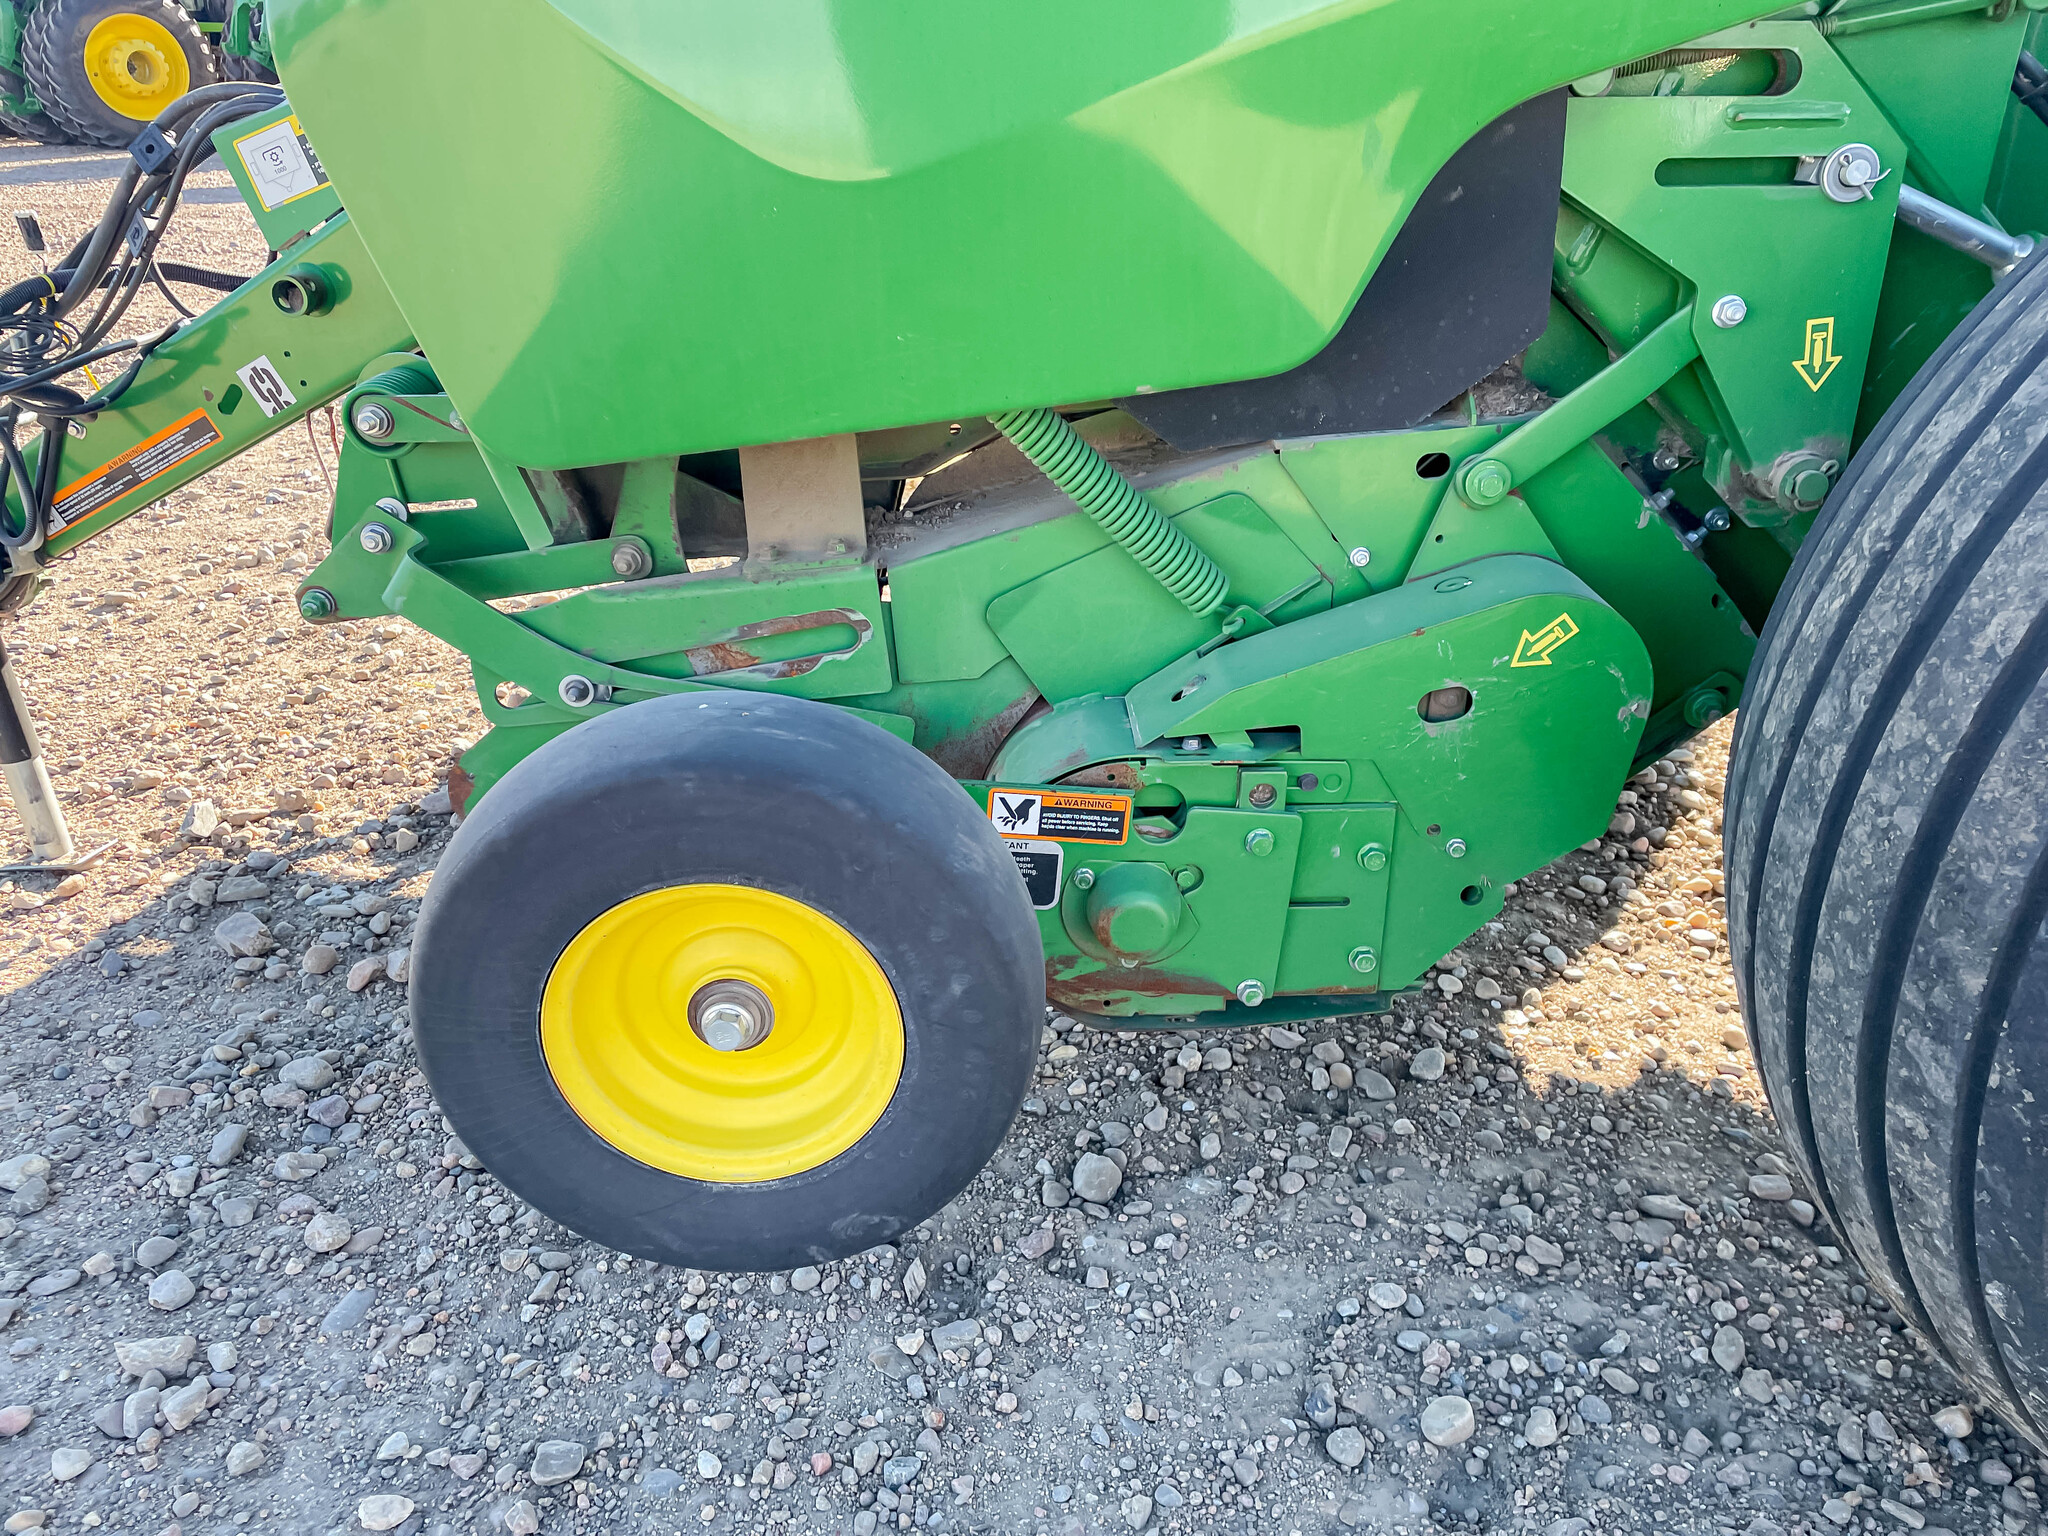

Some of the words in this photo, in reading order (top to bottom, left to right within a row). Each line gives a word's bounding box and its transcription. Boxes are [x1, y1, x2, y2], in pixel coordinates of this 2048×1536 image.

[274, 166, 287, 175] 1000
[111, 445, 144, 468] WARNING
[1063, 798, 1113, 809] WARNING
